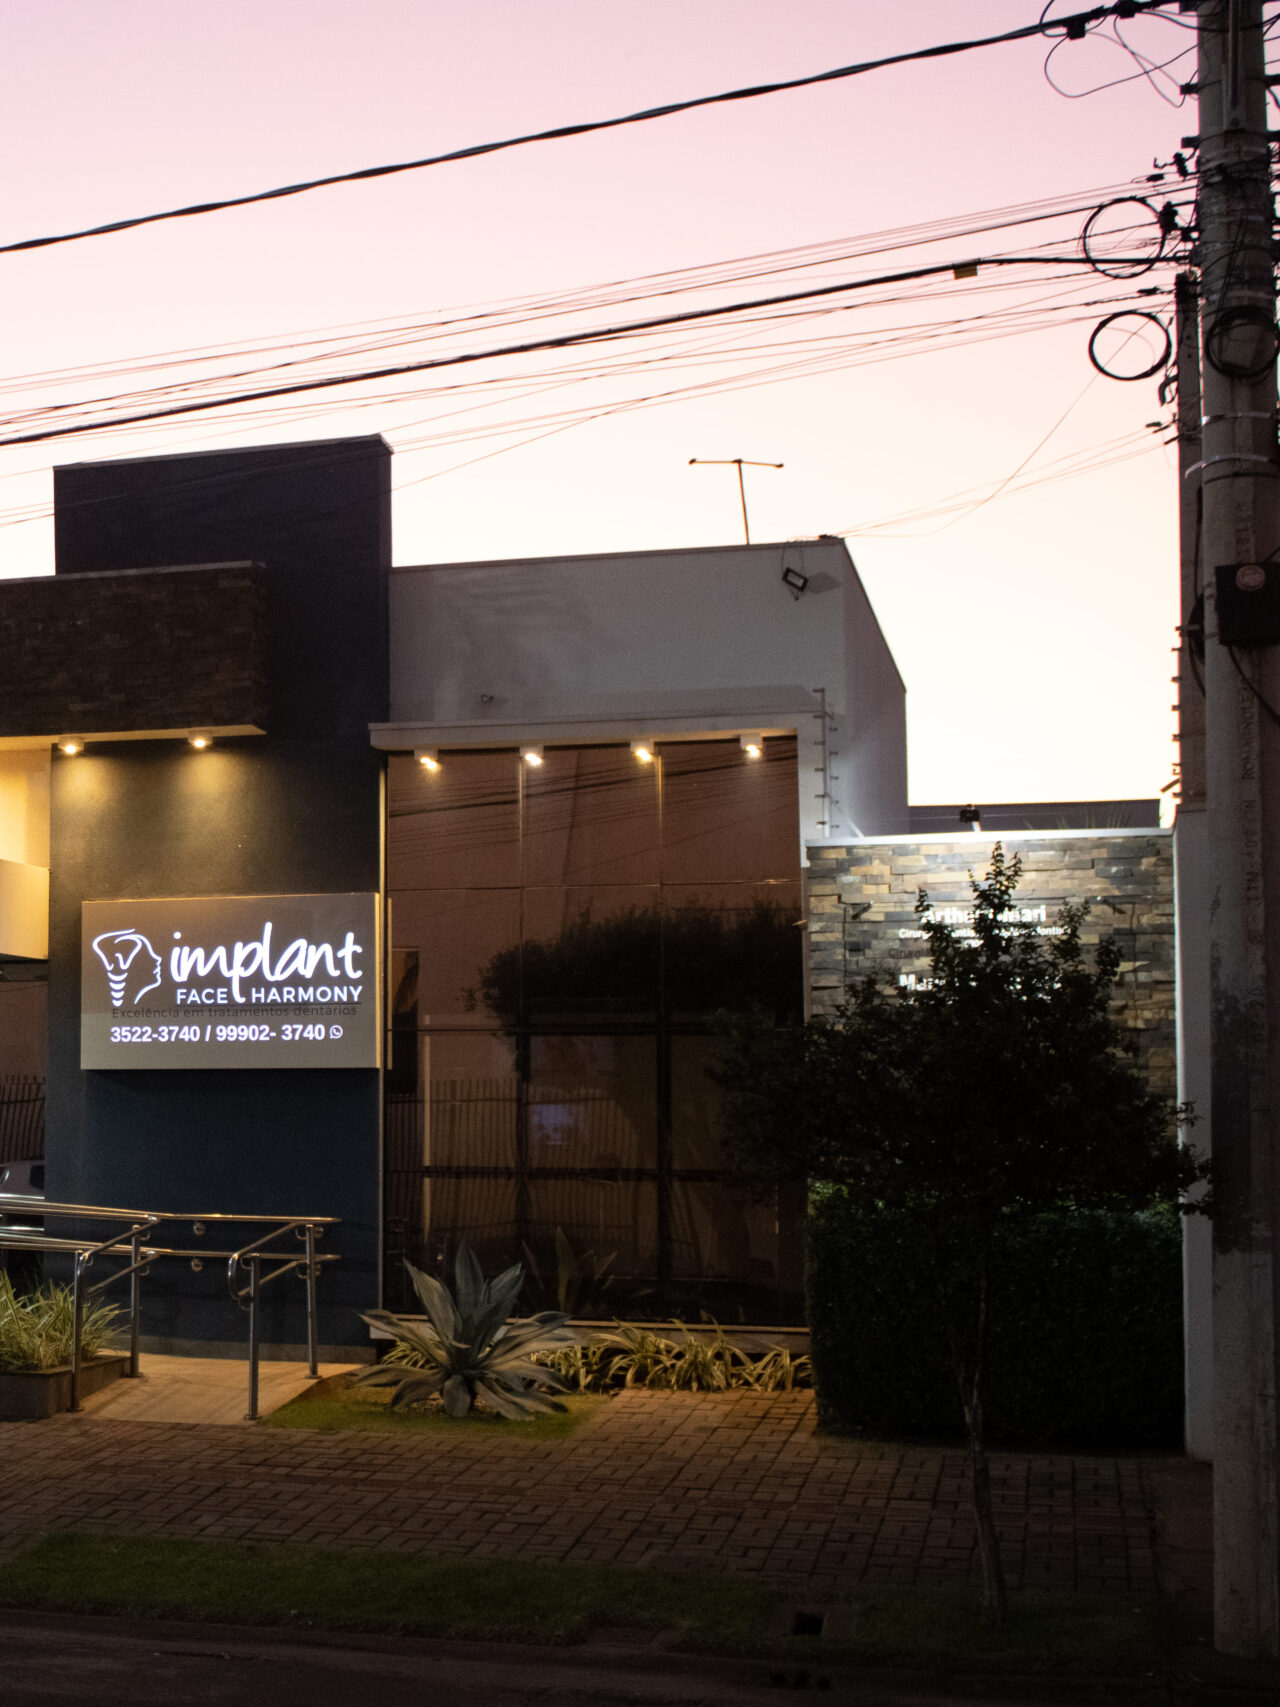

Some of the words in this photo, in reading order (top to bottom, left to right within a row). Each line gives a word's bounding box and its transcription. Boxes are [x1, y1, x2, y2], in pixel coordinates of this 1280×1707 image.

[170, 921, 363, 1004] implant
[176, 988, 229, 1004] FACE
[251, 986, 363, 1003] HARMONY
[184, 1008, 204, 1018] em
[208, 1005, 289, 1017] tratamentos
[110, 1026, 201, 1042] 3522-3740
[216, 1025, 276, 1041] 99902-
[281, 1024, 326, 1041] 3740
